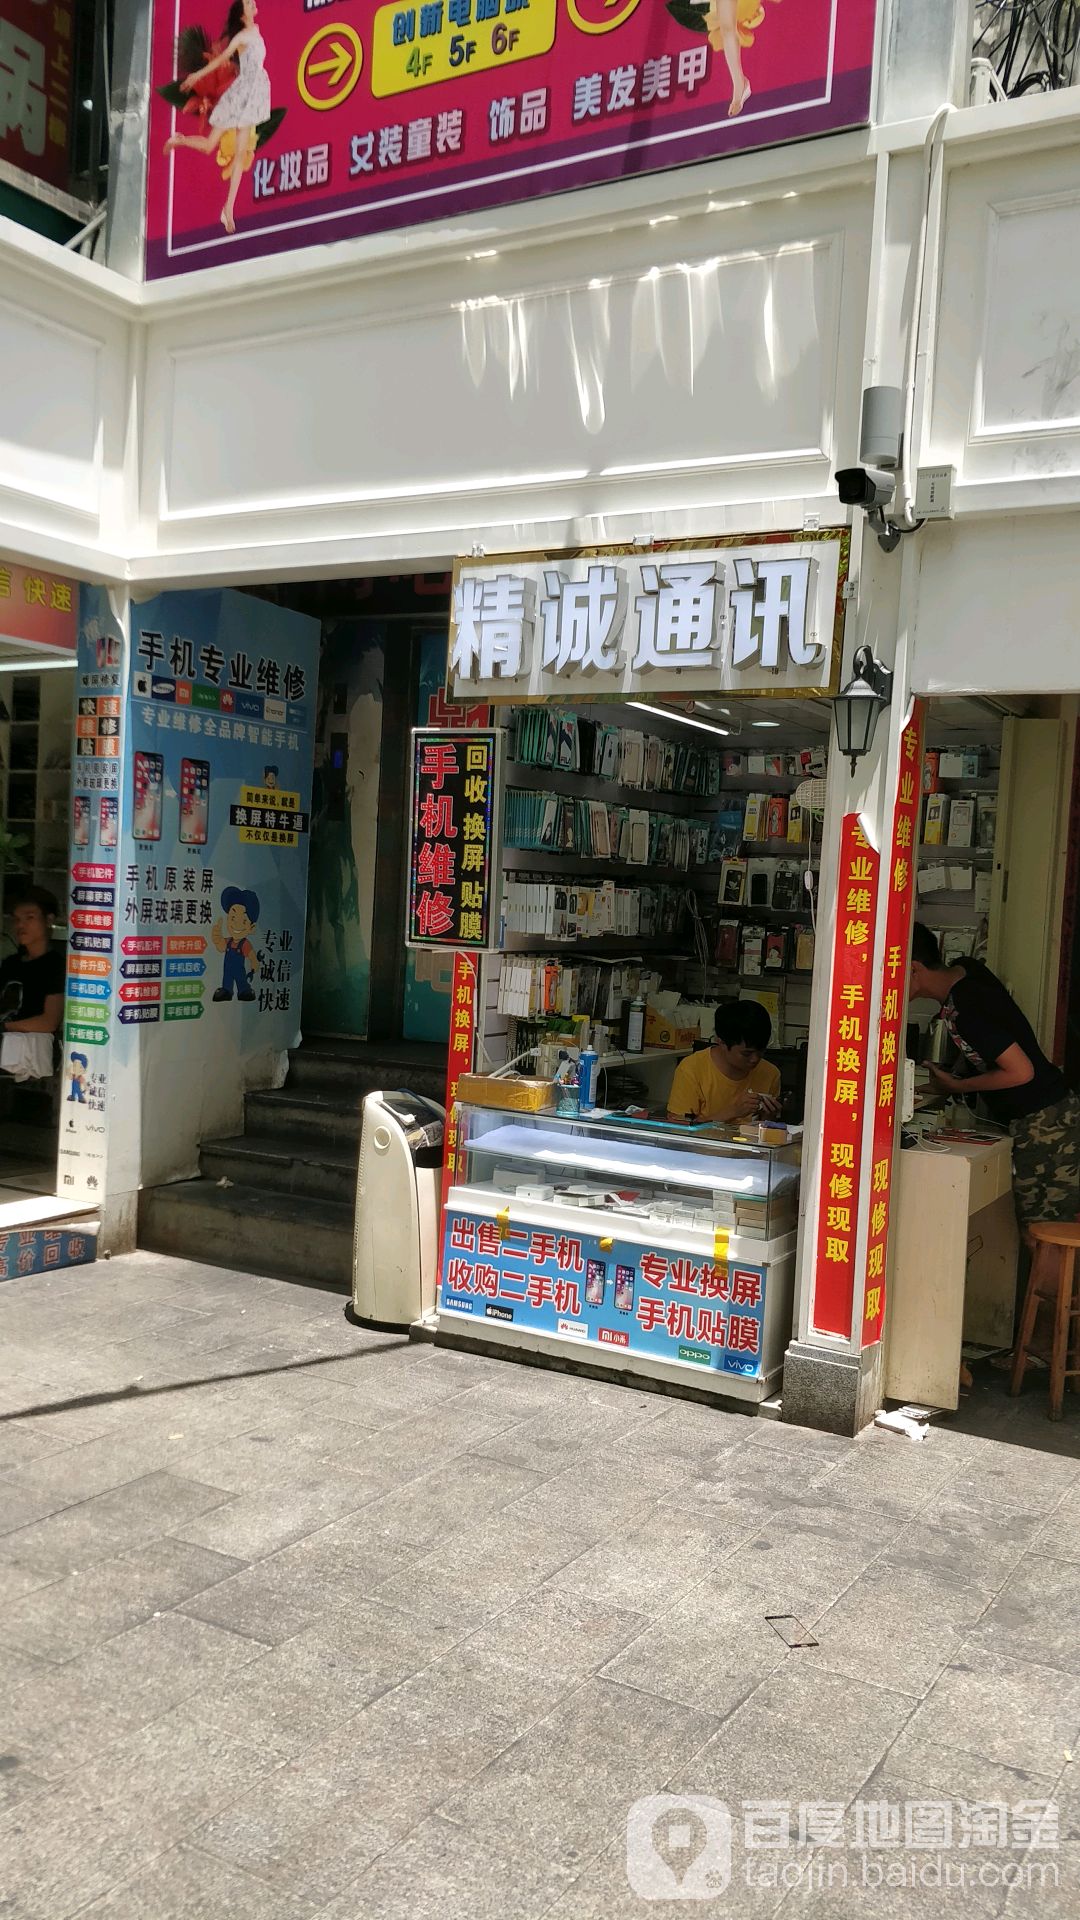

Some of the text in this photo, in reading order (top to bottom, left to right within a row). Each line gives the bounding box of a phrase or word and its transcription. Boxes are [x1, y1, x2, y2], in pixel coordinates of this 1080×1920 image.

[406, 23, 520, 78] 4F 5F 6F
[252, 46, 709, 199] 化妆品 女装童装 饰品 美发美甲
[23, 576, 72, 613] 快速
[451, 557, 823, 681] 精诚通讯
[138, 630, 307, 701] 手机专业维修
[142, 704, 299, 751] 专业维修全品牌智能手机
[235, 807, 304, 831] 换屏特牛逼
[246, 829, 295, 844] 不仅仅是换屏
[417, 744, 459, 936] 手机维修
[126, 865, 214, 894] 手机原装屏
[125, 896, 213, 924] 外屏玻璃更换
[127, 940, 161, 951] 手机配件
[261, 930, 293, 953] 专业
[260, 959, 292, 983] 诚信
[258, 988, 290, 1013] 快速
[91, 1073, 107, 1085] 专业
[450, 1217, 584, 1272] 出售二手机
[448, 1257, 581, 1316] 收购二手机
[640, 1253, 761, 1308] 专业换屏
[446, 1298, 473, 1310] SAMSUNG
[491, 1308, 513, 1320] iPhone
[636, 1296, 760, 1354] 手机贴膜
